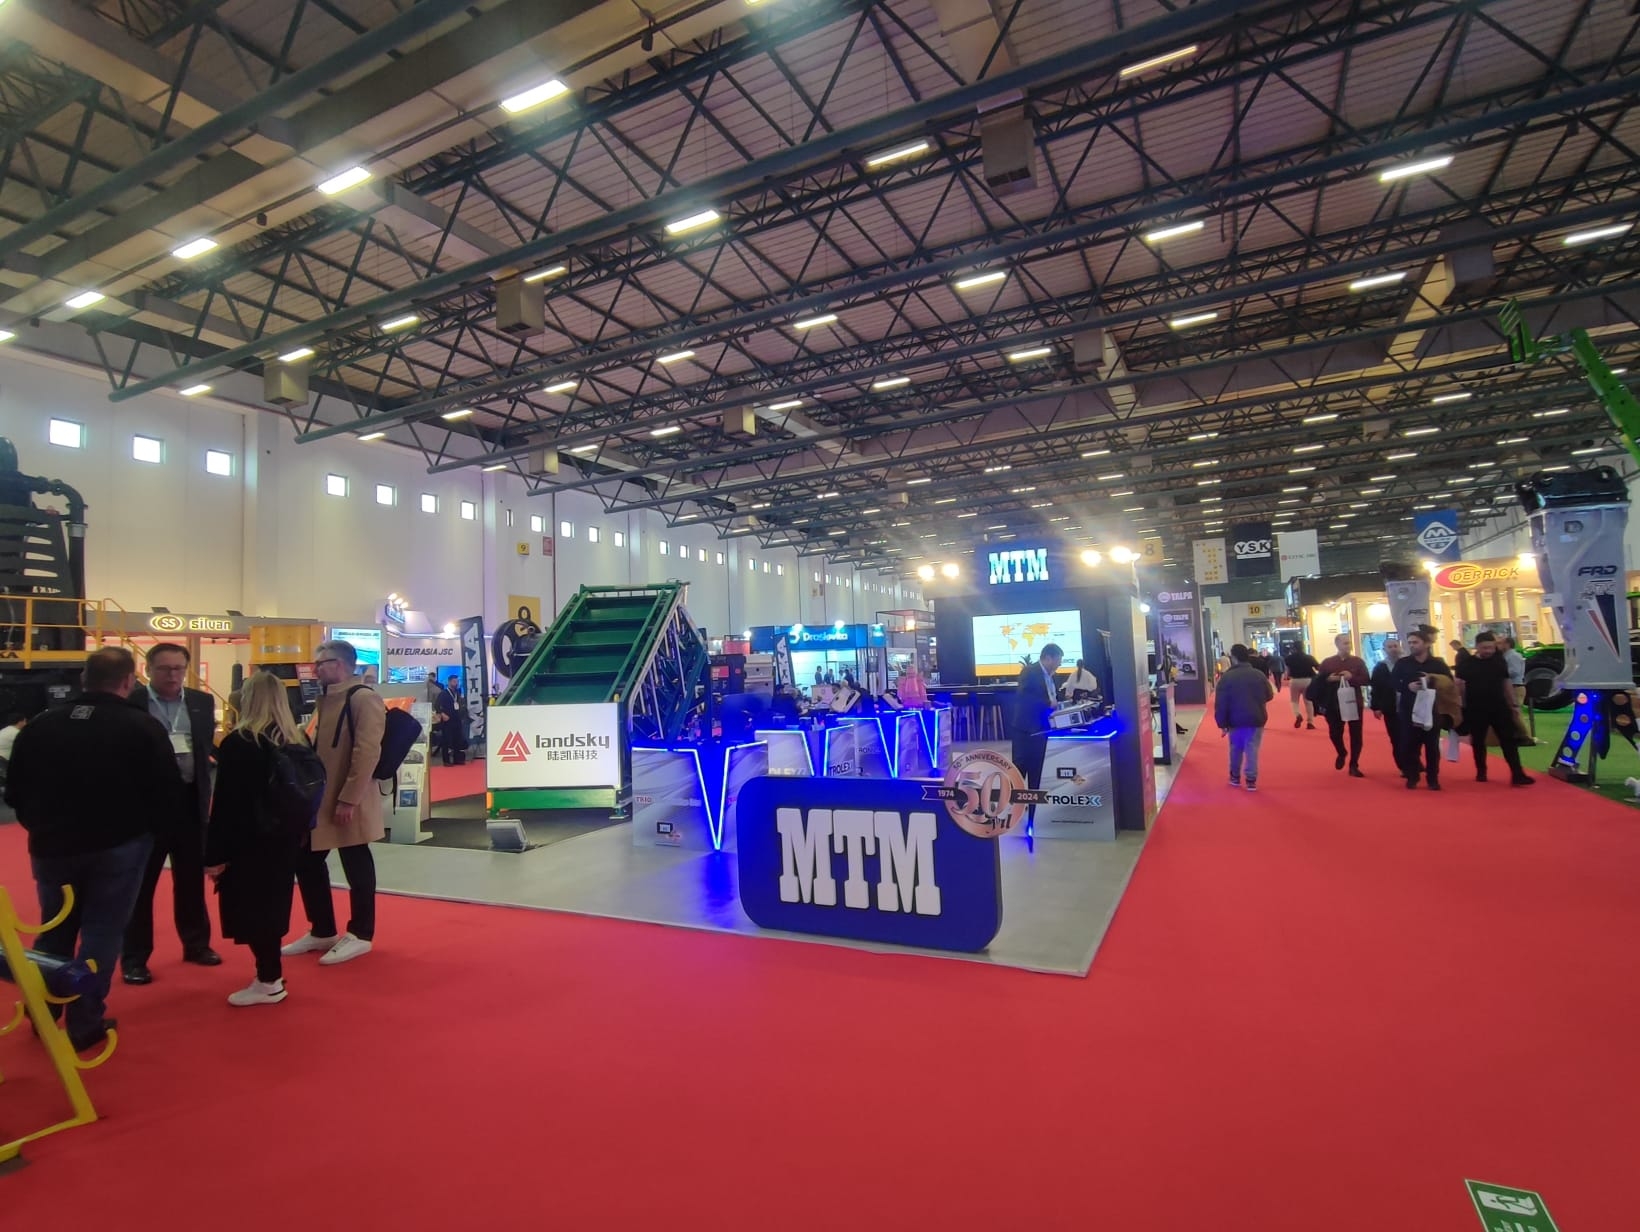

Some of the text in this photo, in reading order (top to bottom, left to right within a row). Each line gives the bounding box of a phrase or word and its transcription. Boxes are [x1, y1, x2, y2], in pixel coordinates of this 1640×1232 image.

[1236, 541, 1268, 553] YSK
[988, 548, 1049, 585] MTM
[1578, 565, 1618, 577] FRD
[1453, 567, 1520, 582] DERRICK
[1249, 606, 1260, 615] 10
[439, 648, 454, 656] JSC
[535, 733, 610, 749] landsky
[965, 754, 1012, 770] ANNIVERSARY
[937, 789, 955, 798] 1974
[951, 771, 1012, 816] 50
[1017, 792, 1039, 801] 2024
[776, 807, 942, 916] MTM
